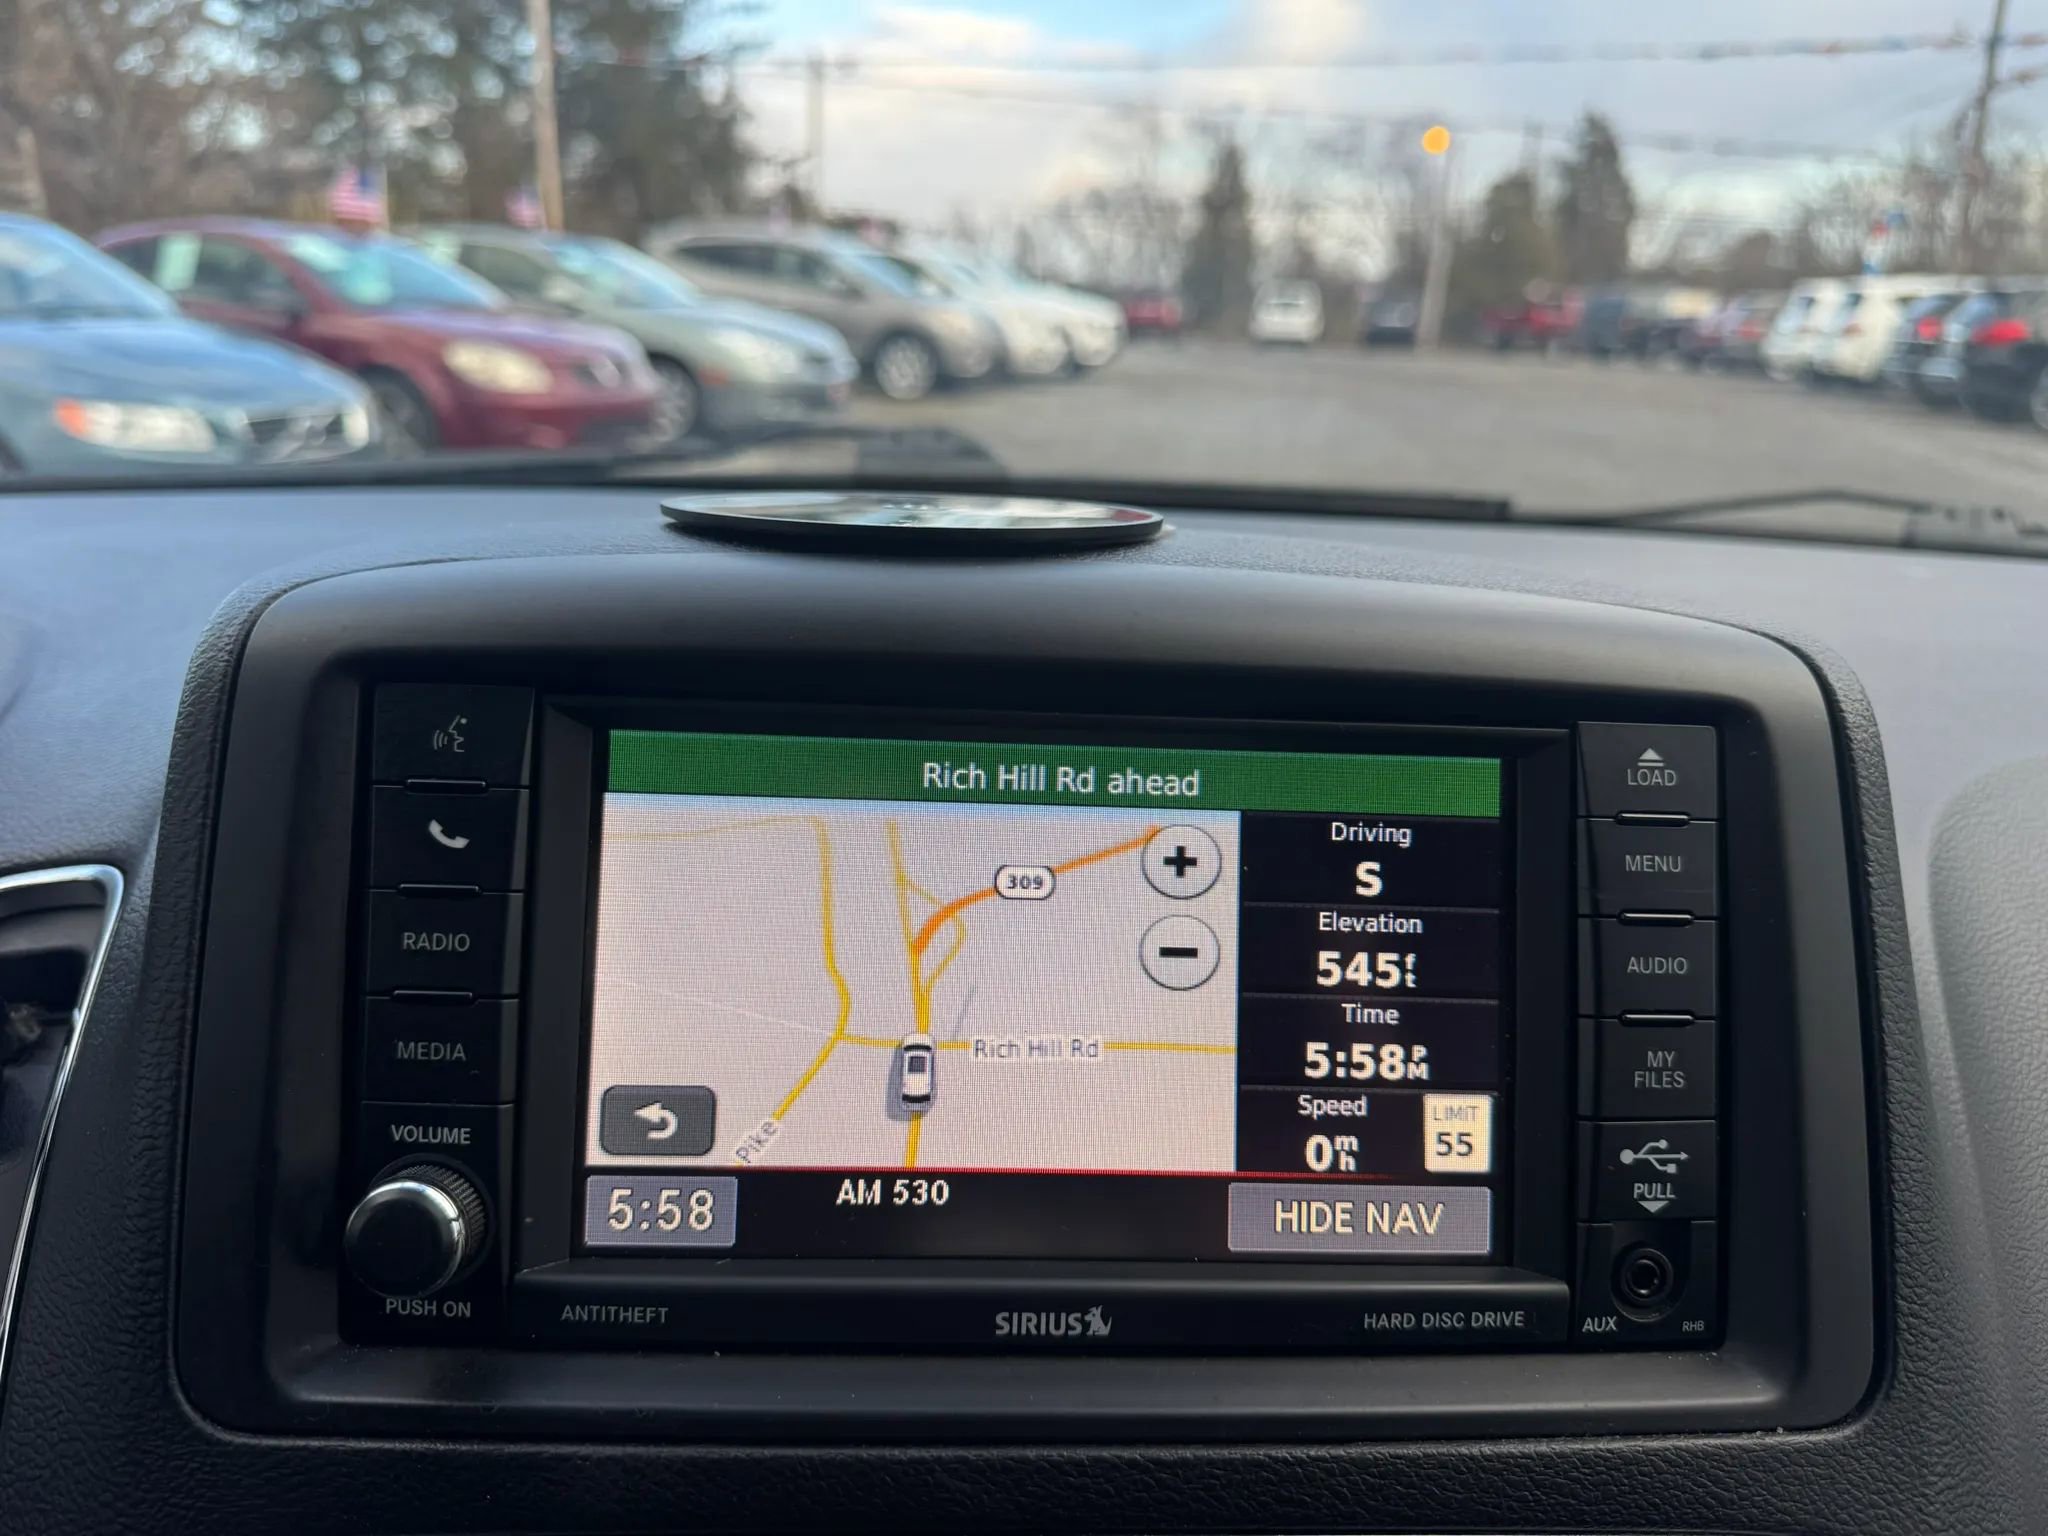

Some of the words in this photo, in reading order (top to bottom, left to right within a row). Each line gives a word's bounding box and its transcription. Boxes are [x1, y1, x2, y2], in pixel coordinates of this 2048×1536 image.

[923, 762, 987, 790] Rich
[998, 764, 1046, 792] Hill
[1057, 766, 1096, 793] Rd
[1107, 768, 1200, 796] ahead
[1627, 769, 1677, 786] LOAD
[1331, 821, 1412, 848] Driving
[1625, 855, 1682, 872] MENU
[1006, 873, 1044, 890] 309
[1356, 861, 1383, 897] S
[1318, 911, 1423, 935] Elevation
[403, 932, 470, 952] RADIO
[1627, 957, 1688, 974] AUDIO
[1341, 1003, 1400, 1025] Time
[397, 1042, 467, 1061] MEDIA
[974, 1039, 1021, 1059] Rich
[1028, 1039, 1063, 1058] Hill
[1070, 1039, 1099, 1058] Rd
[1647, 1051, 1675, 1067] MY
[1634, 1071, 1685, 1088] FILES
[1297, 1094, 1368, 1120] Speed
[1433, 1105, 1479, 1122] LIMIT
[391, 1125, 471, 1144] VOLUME
[1436, 1132, 1473, 1156] 55
[836, 1179, 882, 1205] AM
[892, 1179, 949, 1205] 530
[1633, 1183, 1675, 1199] PULL
[607, 1188, 714, 1232] 5:58
[1274, 1200, 1353, 1233] HIDE
[1366, 1202, 1444, 1235] NAV
[386, 1298, 437, 1316] PUSH
[443, 1301, 471, 1317] ON
[561, 1304, 669, 1323] ANTITHEFT
[995, 1312, 1082, 1335] SIRIUS
[1364, 1313, 1415, 1329] HARD
[1421, 1312, 1464, 1328] DISC
[1471, 1311, 1525, 1327] DRIVE
[1582, 1316, 1617, 1332] AUX
[1682, 1320, 1705, 1332] RHB
